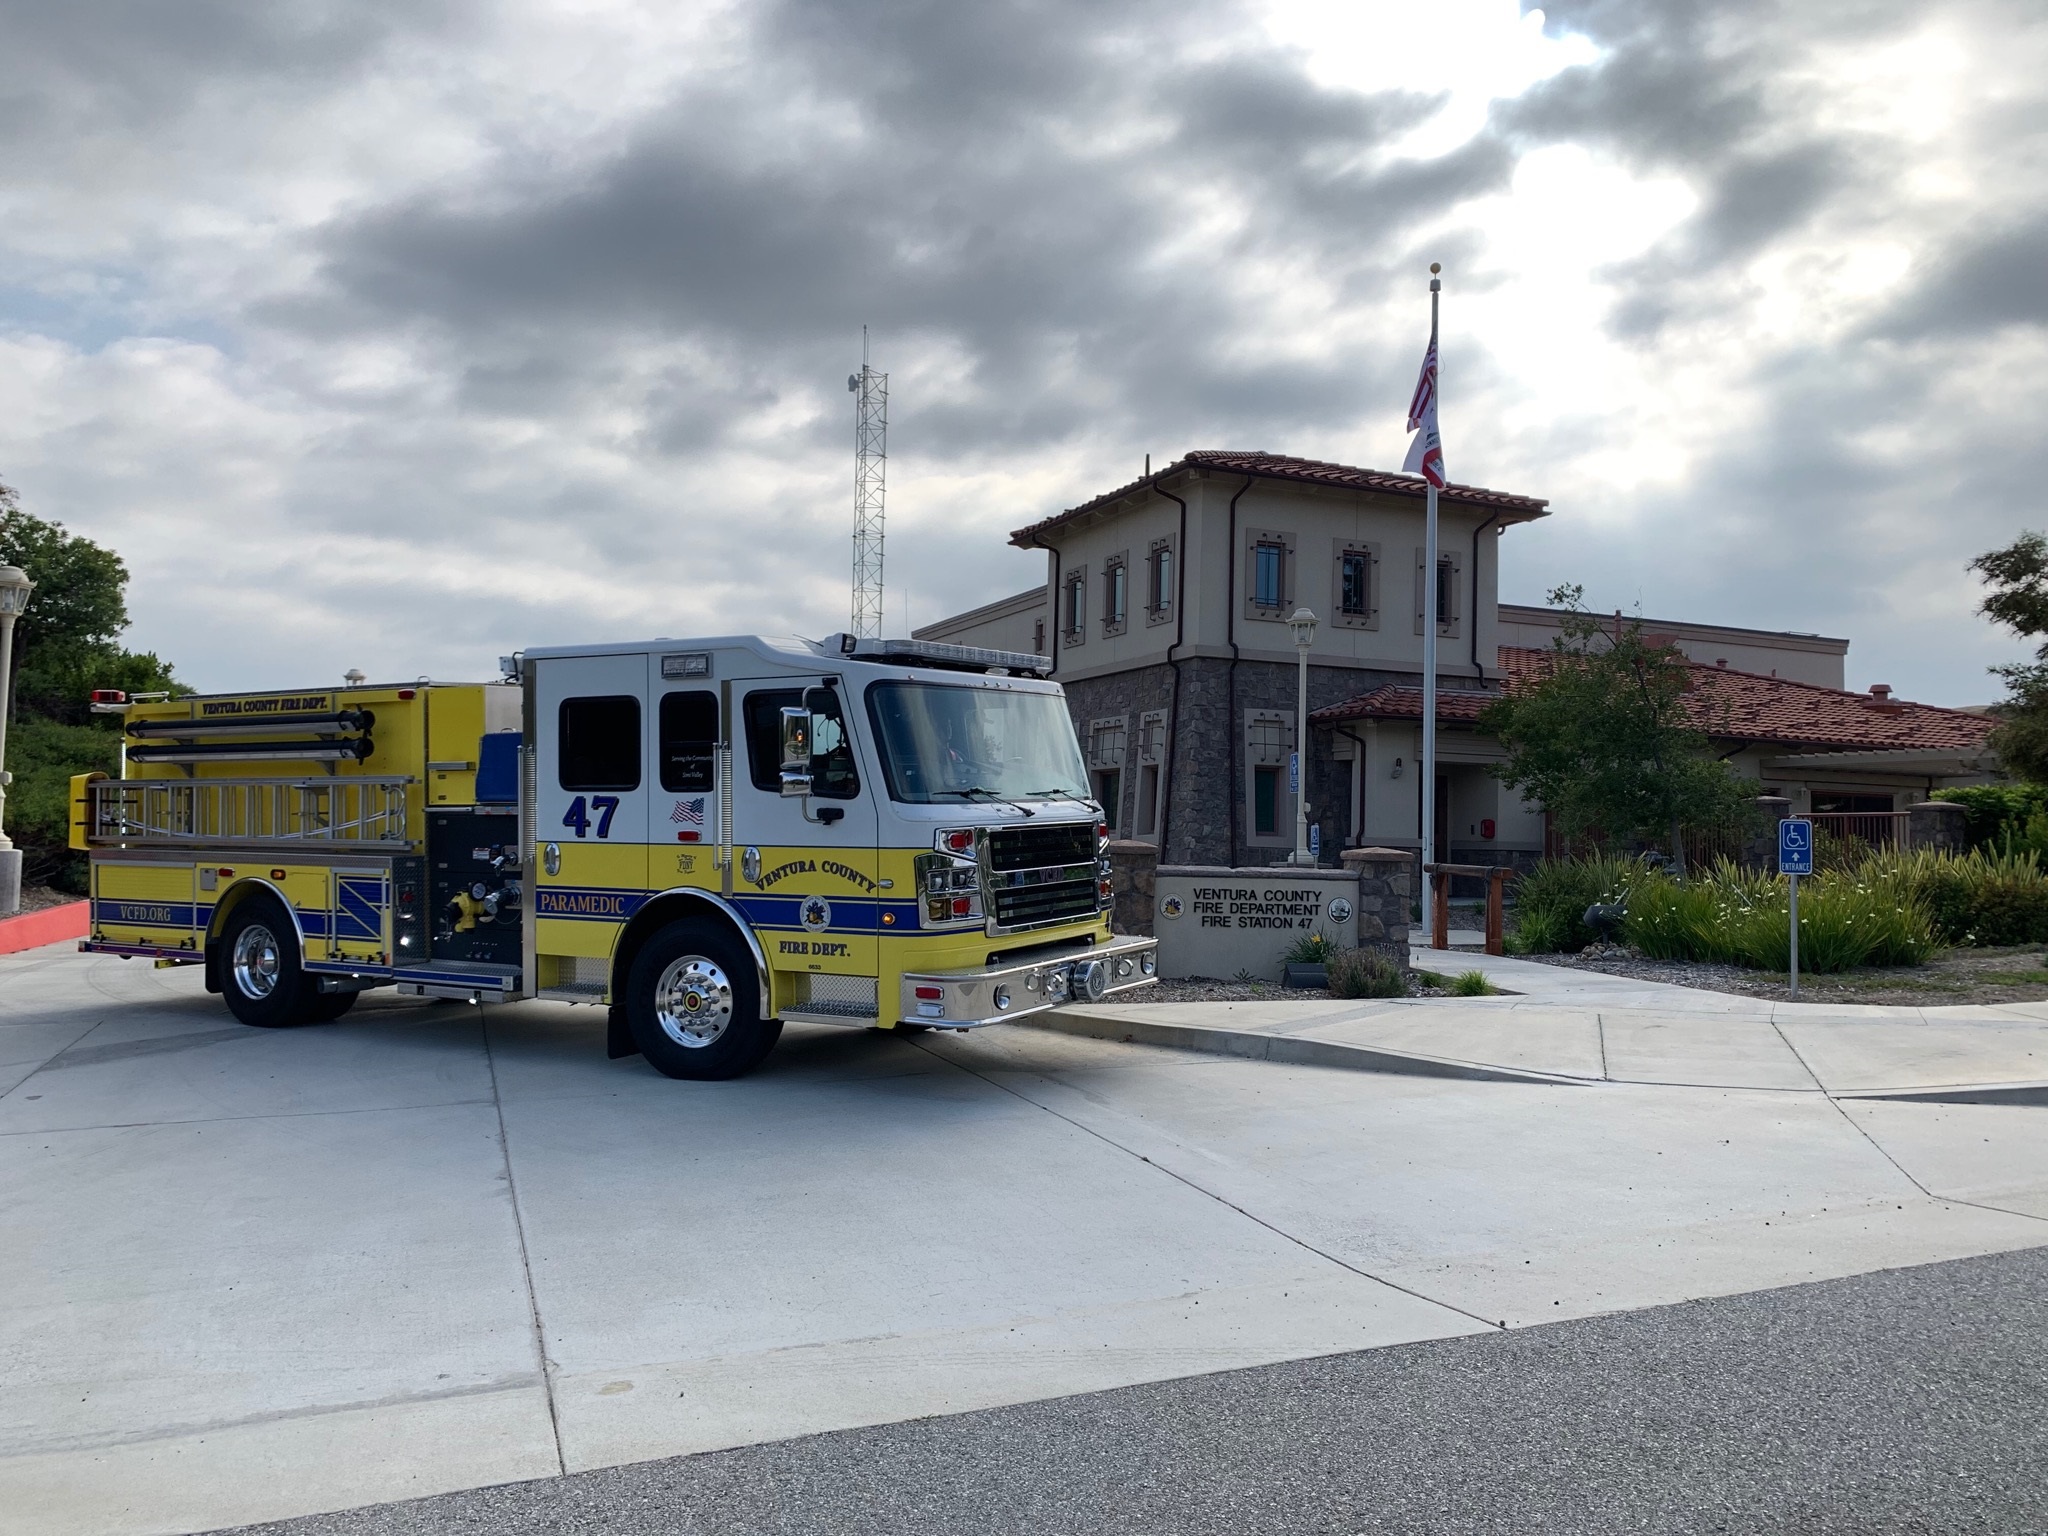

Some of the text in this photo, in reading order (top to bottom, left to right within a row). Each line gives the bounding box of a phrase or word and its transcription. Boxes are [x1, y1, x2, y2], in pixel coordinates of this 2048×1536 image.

[202, 697, 328, 715] VENTURA COUNTY FIRE DEPT.
[671, 755, 685, 763] Serving
[691, 771, 703, 779] Valley
[562, 795, 620, 838] 47
[1781, 862, 1810, 872] ENTRANCE
[755, 859, 877, 893] VENTURA COUNTY
[1193, 888, 1322, 902] VENTURA COUNTY
[541, 894, 625, 914] PARAMEDIC
[1193, 902, 1224, 914] FIRE
[1229, 902, 1321, 916] DEPARTMENT
[120, 905, 171, 921] VCFD.ORG
[1201, 915, 1313, 930] FIRE STATION 47
[779, 941, 851, 957] FIRE DEPT.
